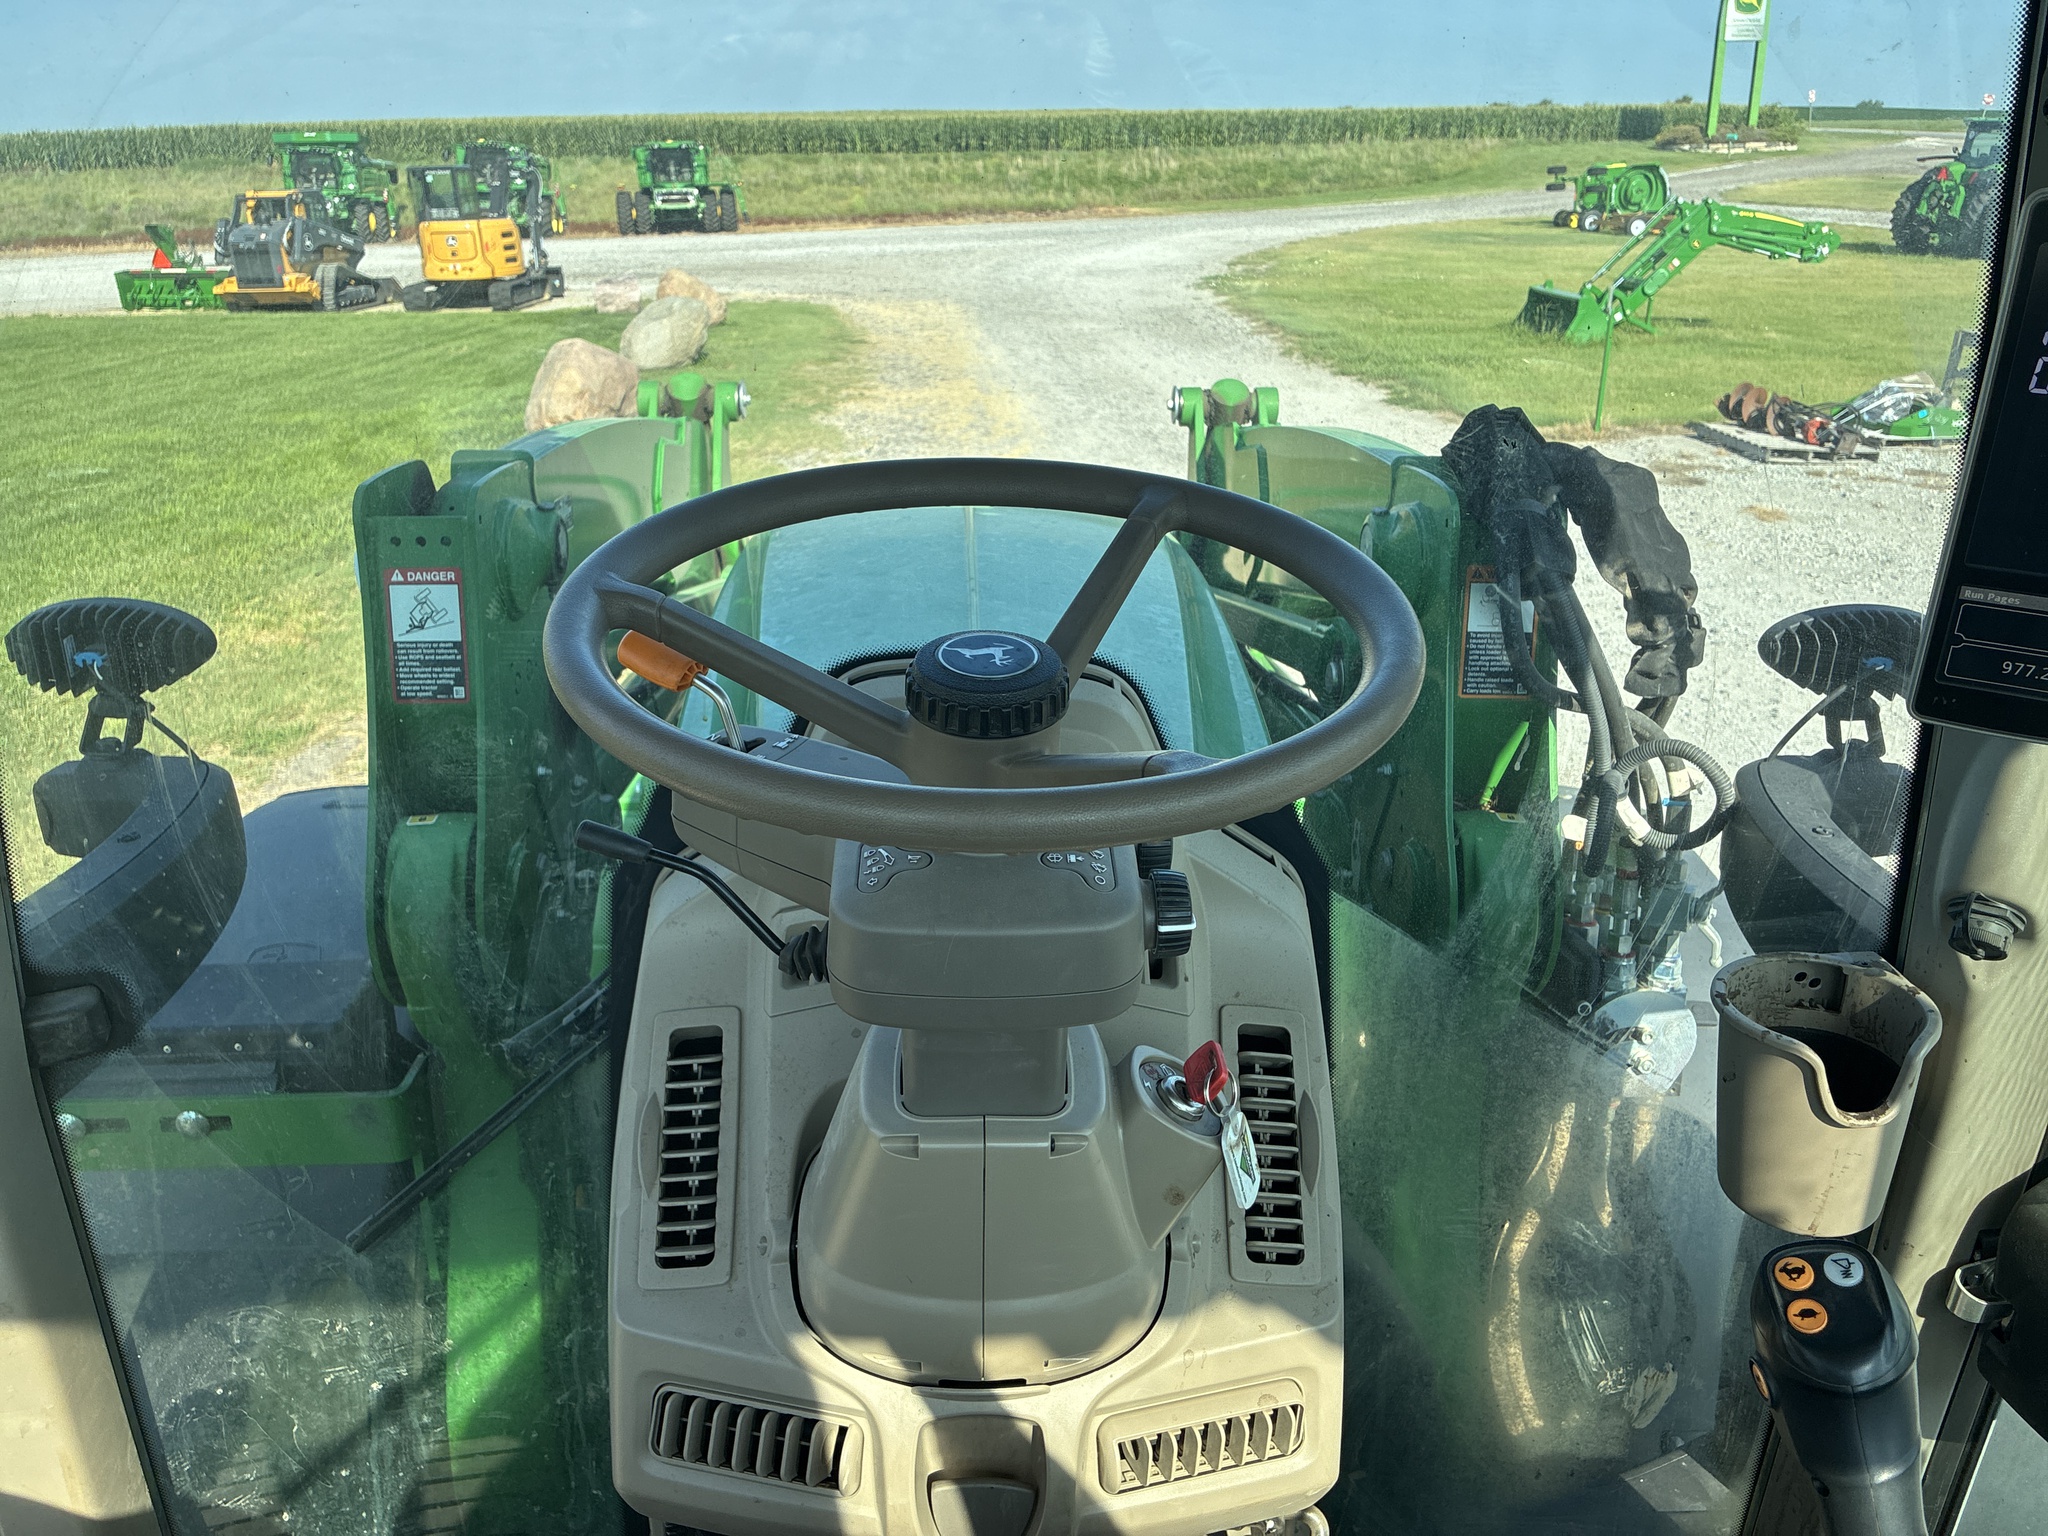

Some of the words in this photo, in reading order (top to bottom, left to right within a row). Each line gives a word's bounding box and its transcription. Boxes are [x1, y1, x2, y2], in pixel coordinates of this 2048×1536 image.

[407, 571, 455, 581] DANGER
[1964, 590, 1984, 599] Run
[1987, 593, 2021, 605] Pages
